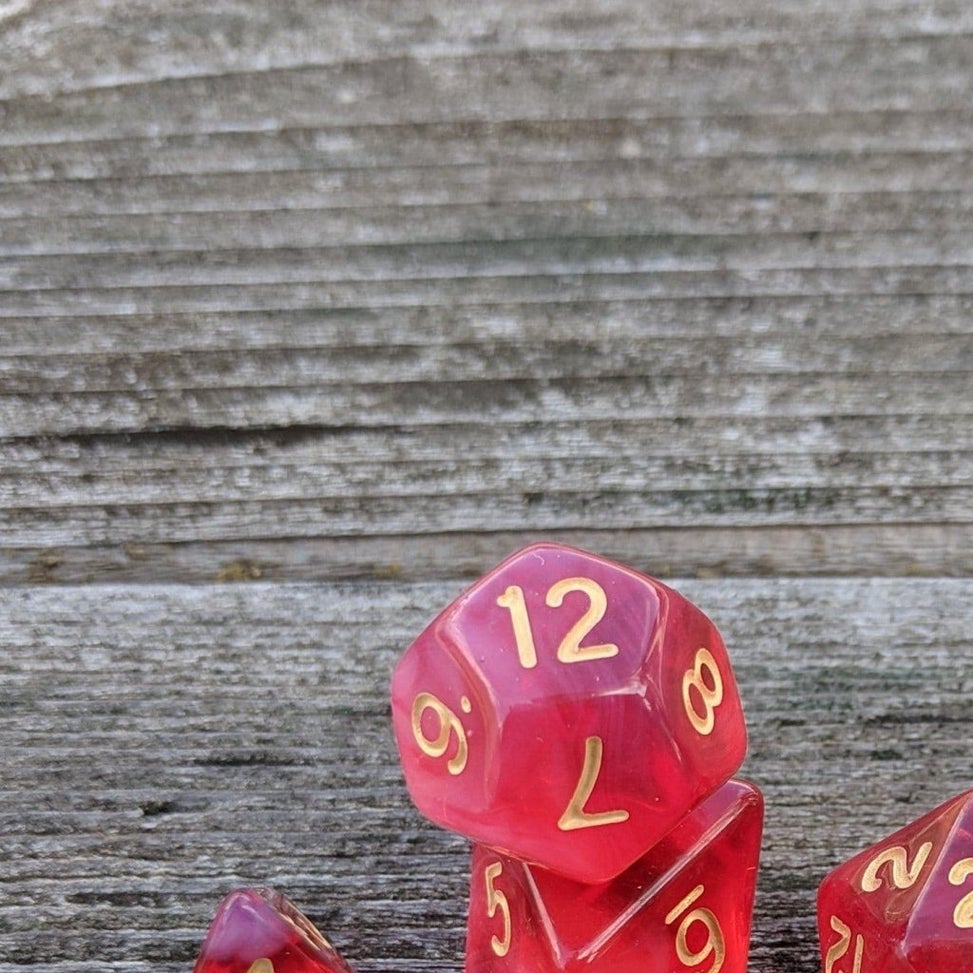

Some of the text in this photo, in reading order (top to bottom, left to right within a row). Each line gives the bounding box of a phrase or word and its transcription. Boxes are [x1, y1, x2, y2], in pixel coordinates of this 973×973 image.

[497, 577, 619, 668] 12
[681, 648, 724, 735] 8
[557, 735, 629, 831] 7
[485, 861, 511, 957] 5
[861, 842, 933, 892] 2
